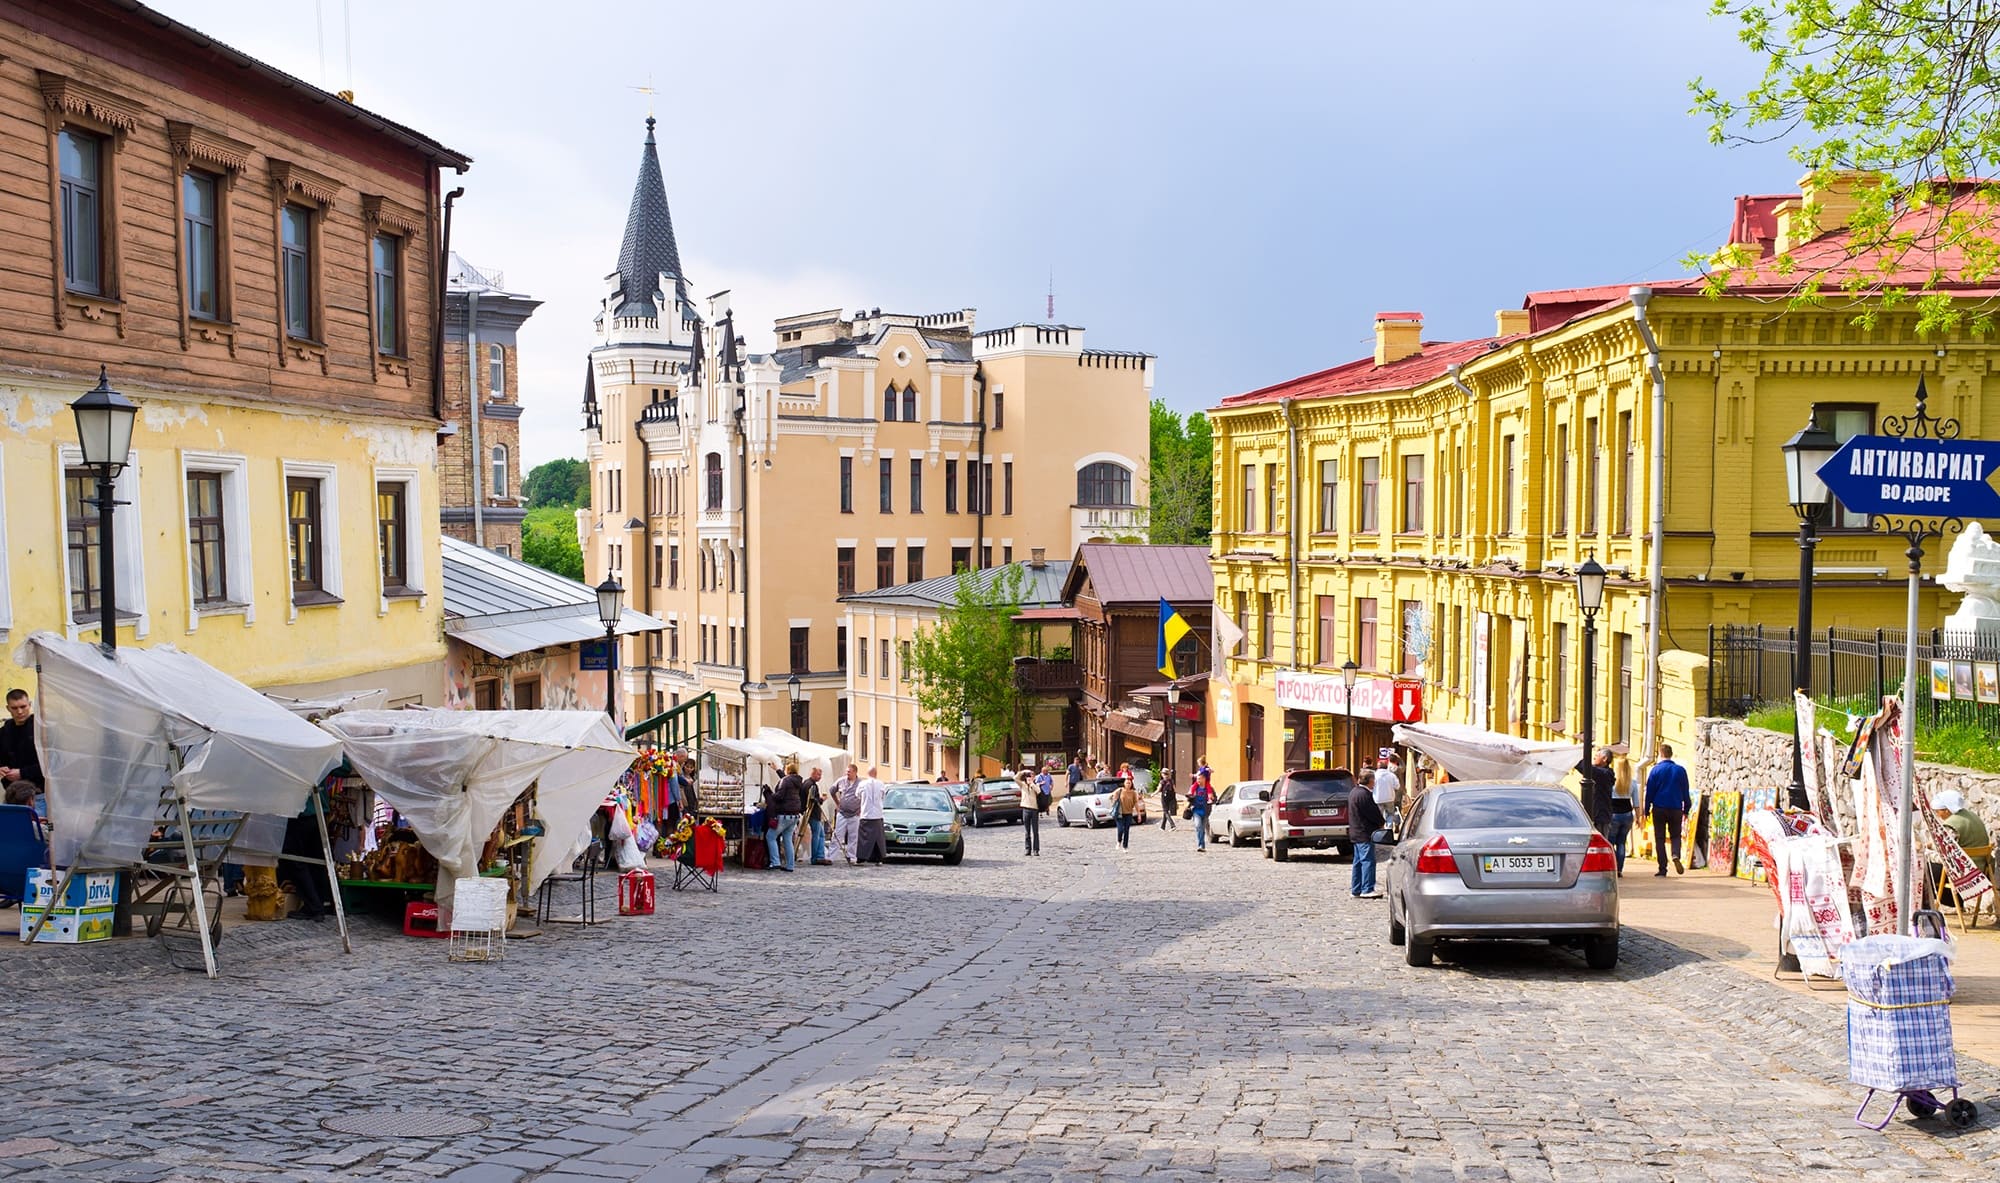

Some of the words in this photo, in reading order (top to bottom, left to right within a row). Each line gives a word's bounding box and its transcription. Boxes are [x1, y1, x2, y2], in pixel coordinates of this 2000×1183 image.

[1850, 448, 1985, 481] АНТИКВАРИАТ
[1881, 483, 1900, 500] ВО
[1902, 485, 1951, 503] ДВОРЕ
[1394, 681, 1421, 690] Grocery
[1373, 690, 1393, 710] 24
[1492, 858, 1505, 868] AI
[1509, 858, 1533, 868] 5033
[1537, 858, 1550, 868] BI
[88, 884, 110, 900] DIVA
